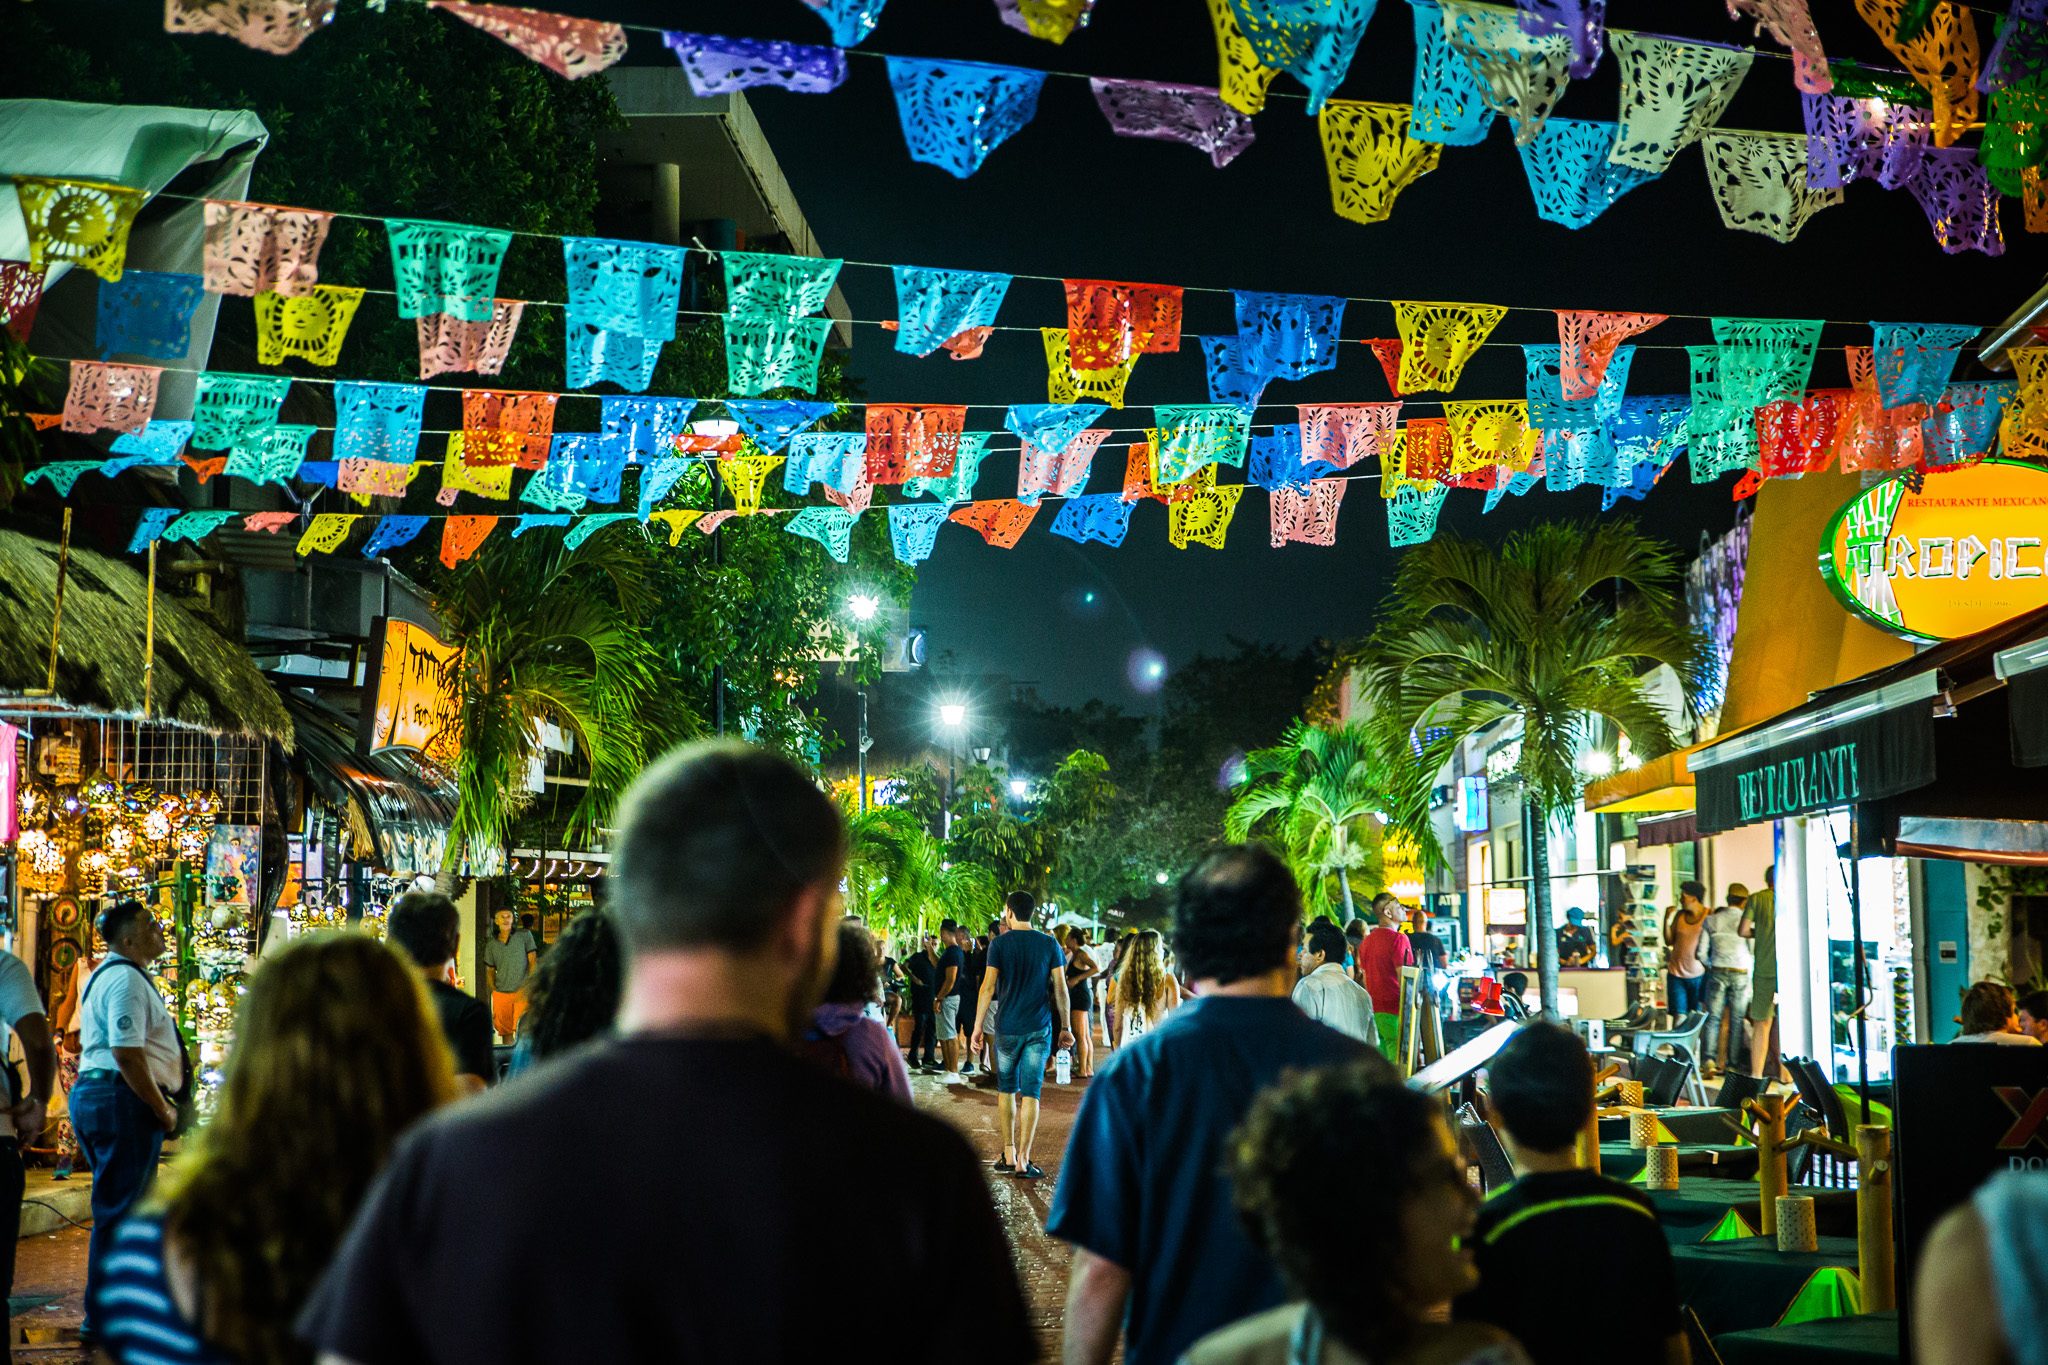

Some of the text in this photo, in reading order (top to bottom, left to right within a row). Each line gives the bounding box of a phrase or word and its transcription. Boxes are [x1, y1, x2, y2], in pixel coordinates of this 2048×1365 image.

[1907, 496, 2048, 508] RESTAURANTE MEXICAN
[1845, 534, 2048, 579] TROPIC
[2008, 1156, 2048, 1173] DO
